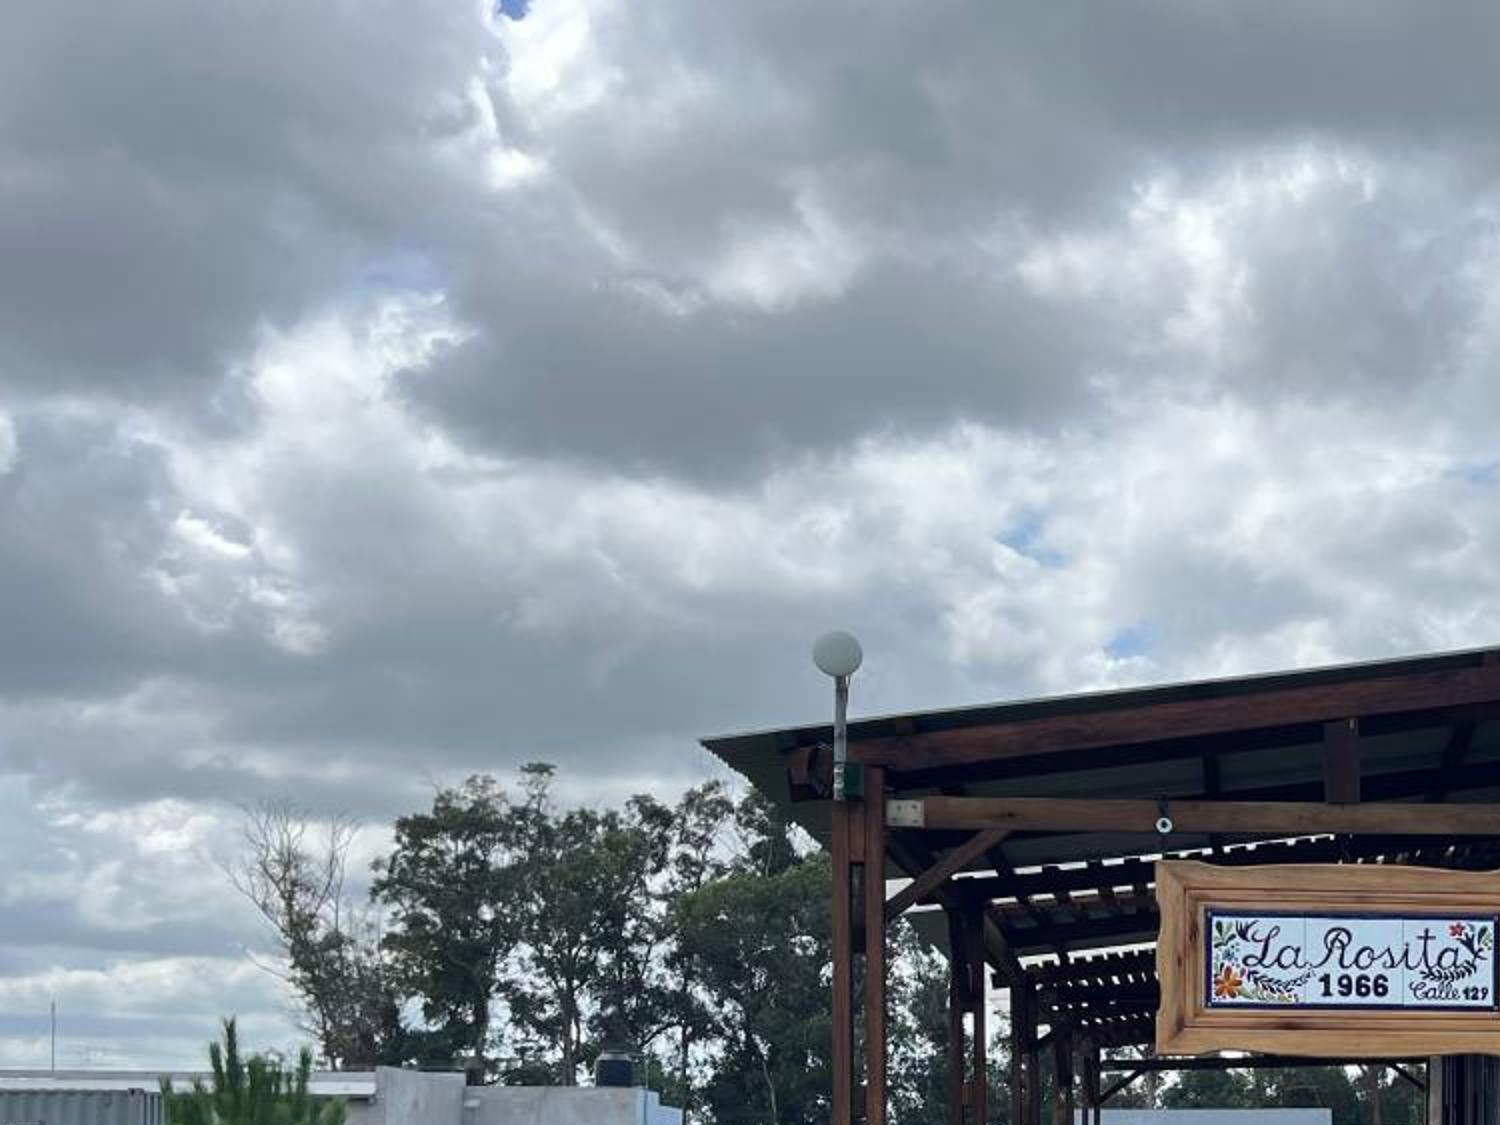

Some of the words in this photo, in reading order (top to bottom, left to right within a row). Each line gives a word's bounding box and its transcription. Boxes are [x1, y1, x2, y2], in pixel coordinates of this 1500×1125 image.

[1242, 925, 1308, 969] La
[1311, 926, 1464, 970] Rosita
[1318, 973, 1389, 998] 1966
[1409, 981, 1461, 1000] Calle
[1463, 985, 1489, 1001] 129
